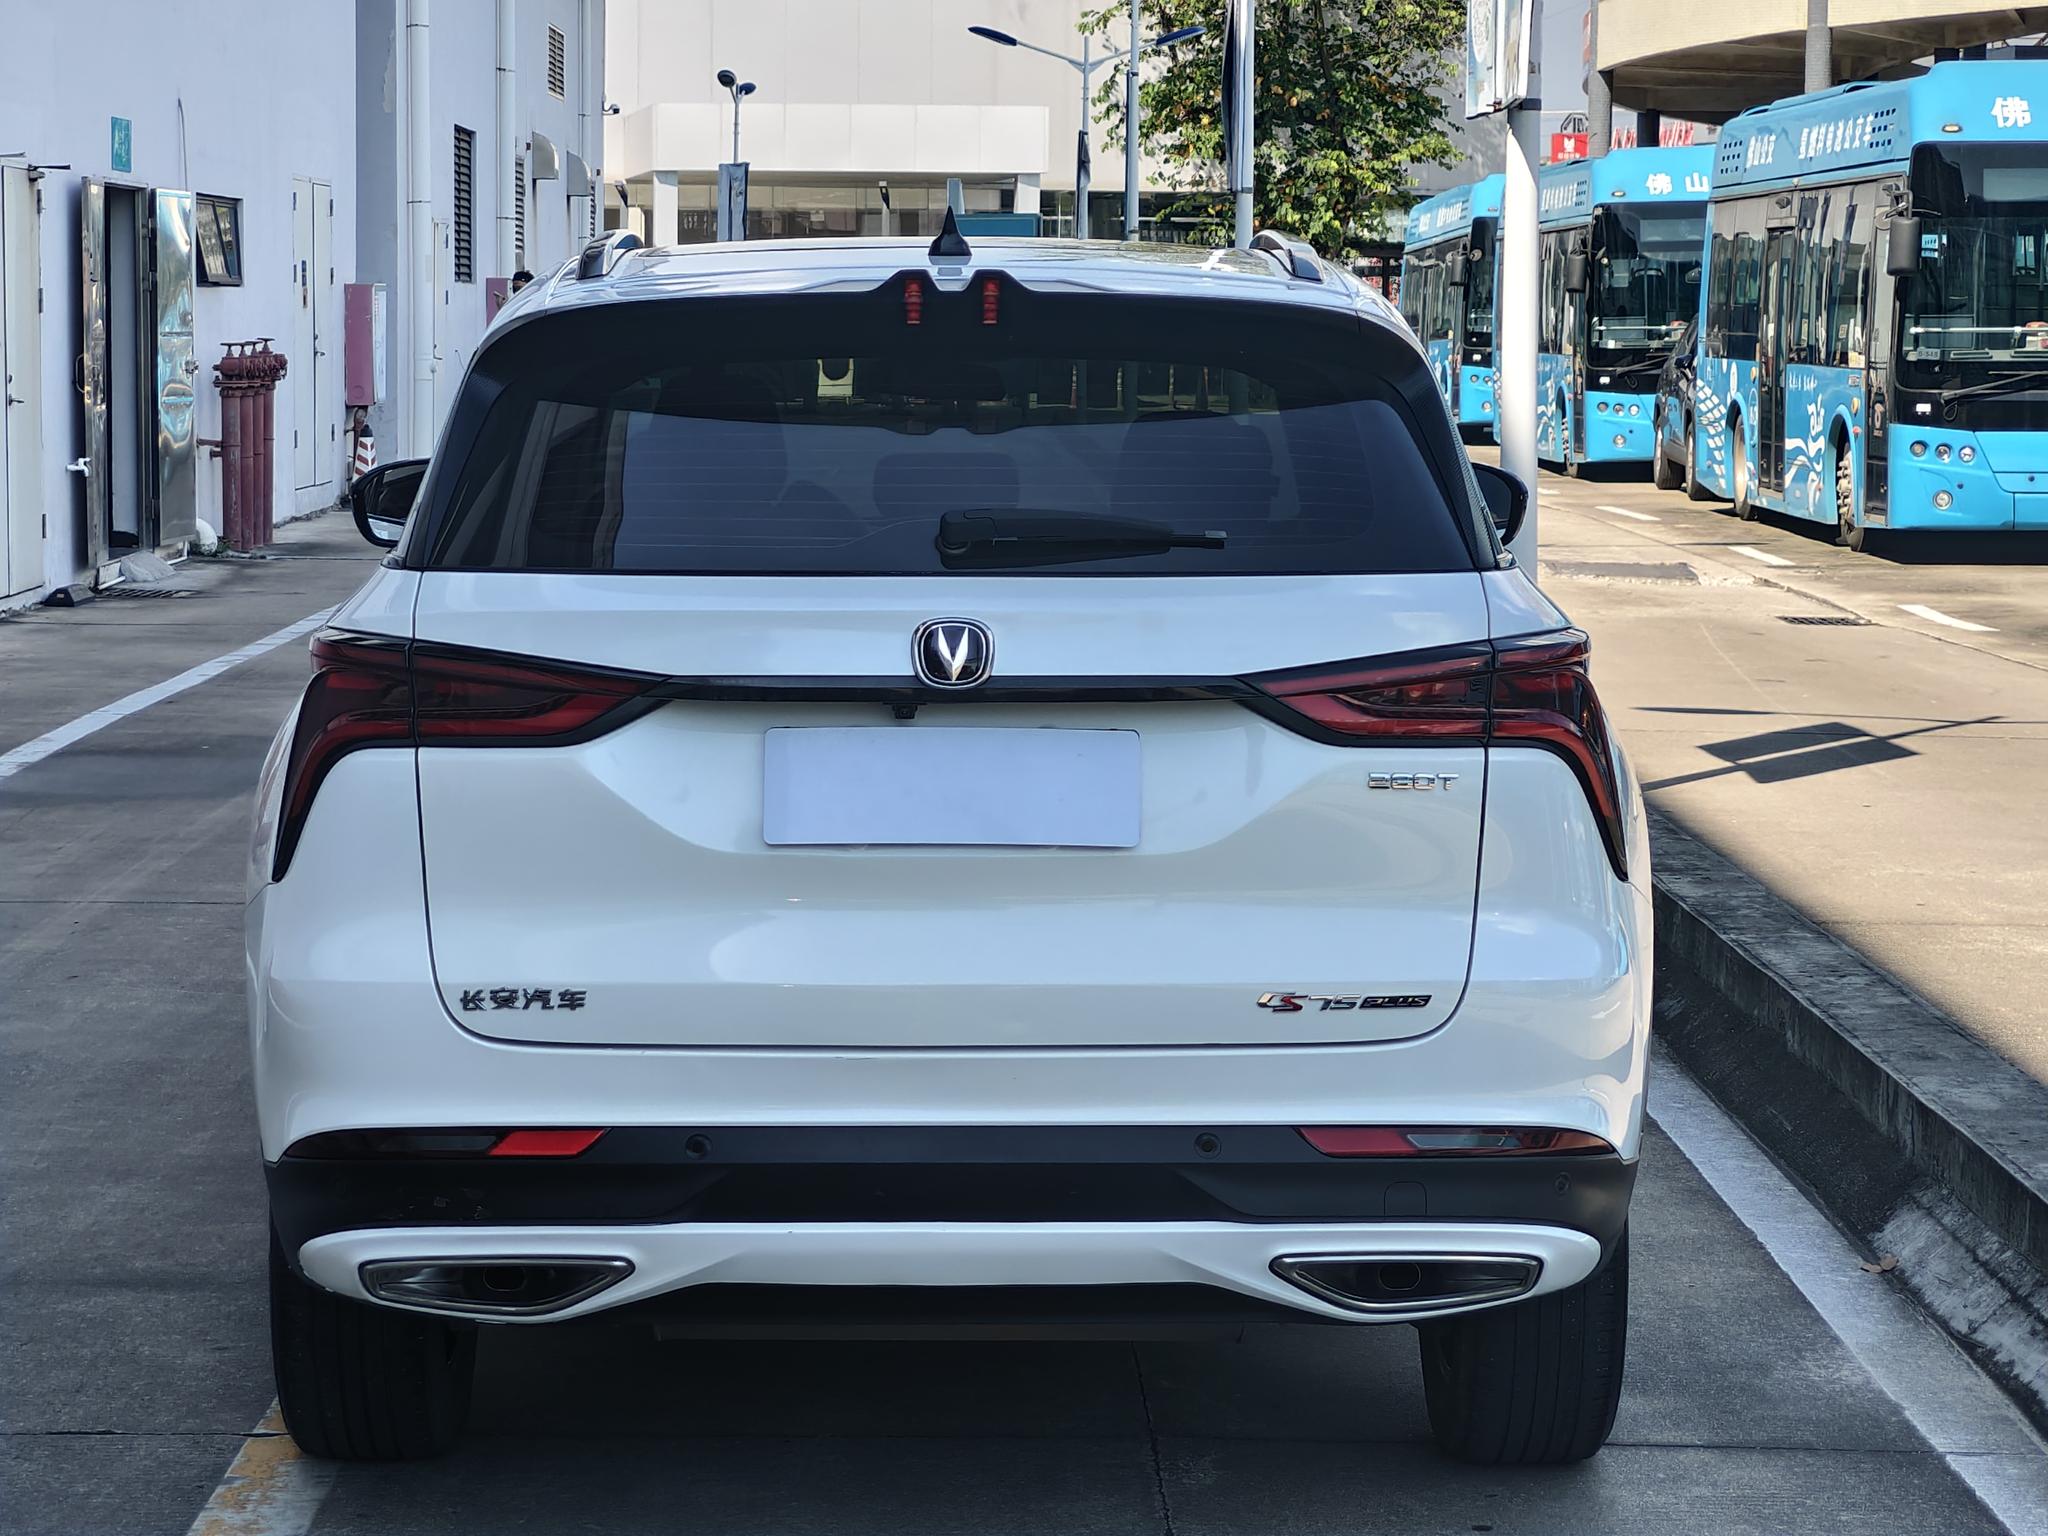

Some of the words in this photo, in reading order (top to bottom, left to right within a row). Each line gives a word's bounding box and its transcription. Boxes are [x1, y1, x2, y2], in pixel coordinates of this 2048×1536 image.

[1991, 96, 2031, 128] 佛
[460, 986, 587, 1011] 长安汽车
